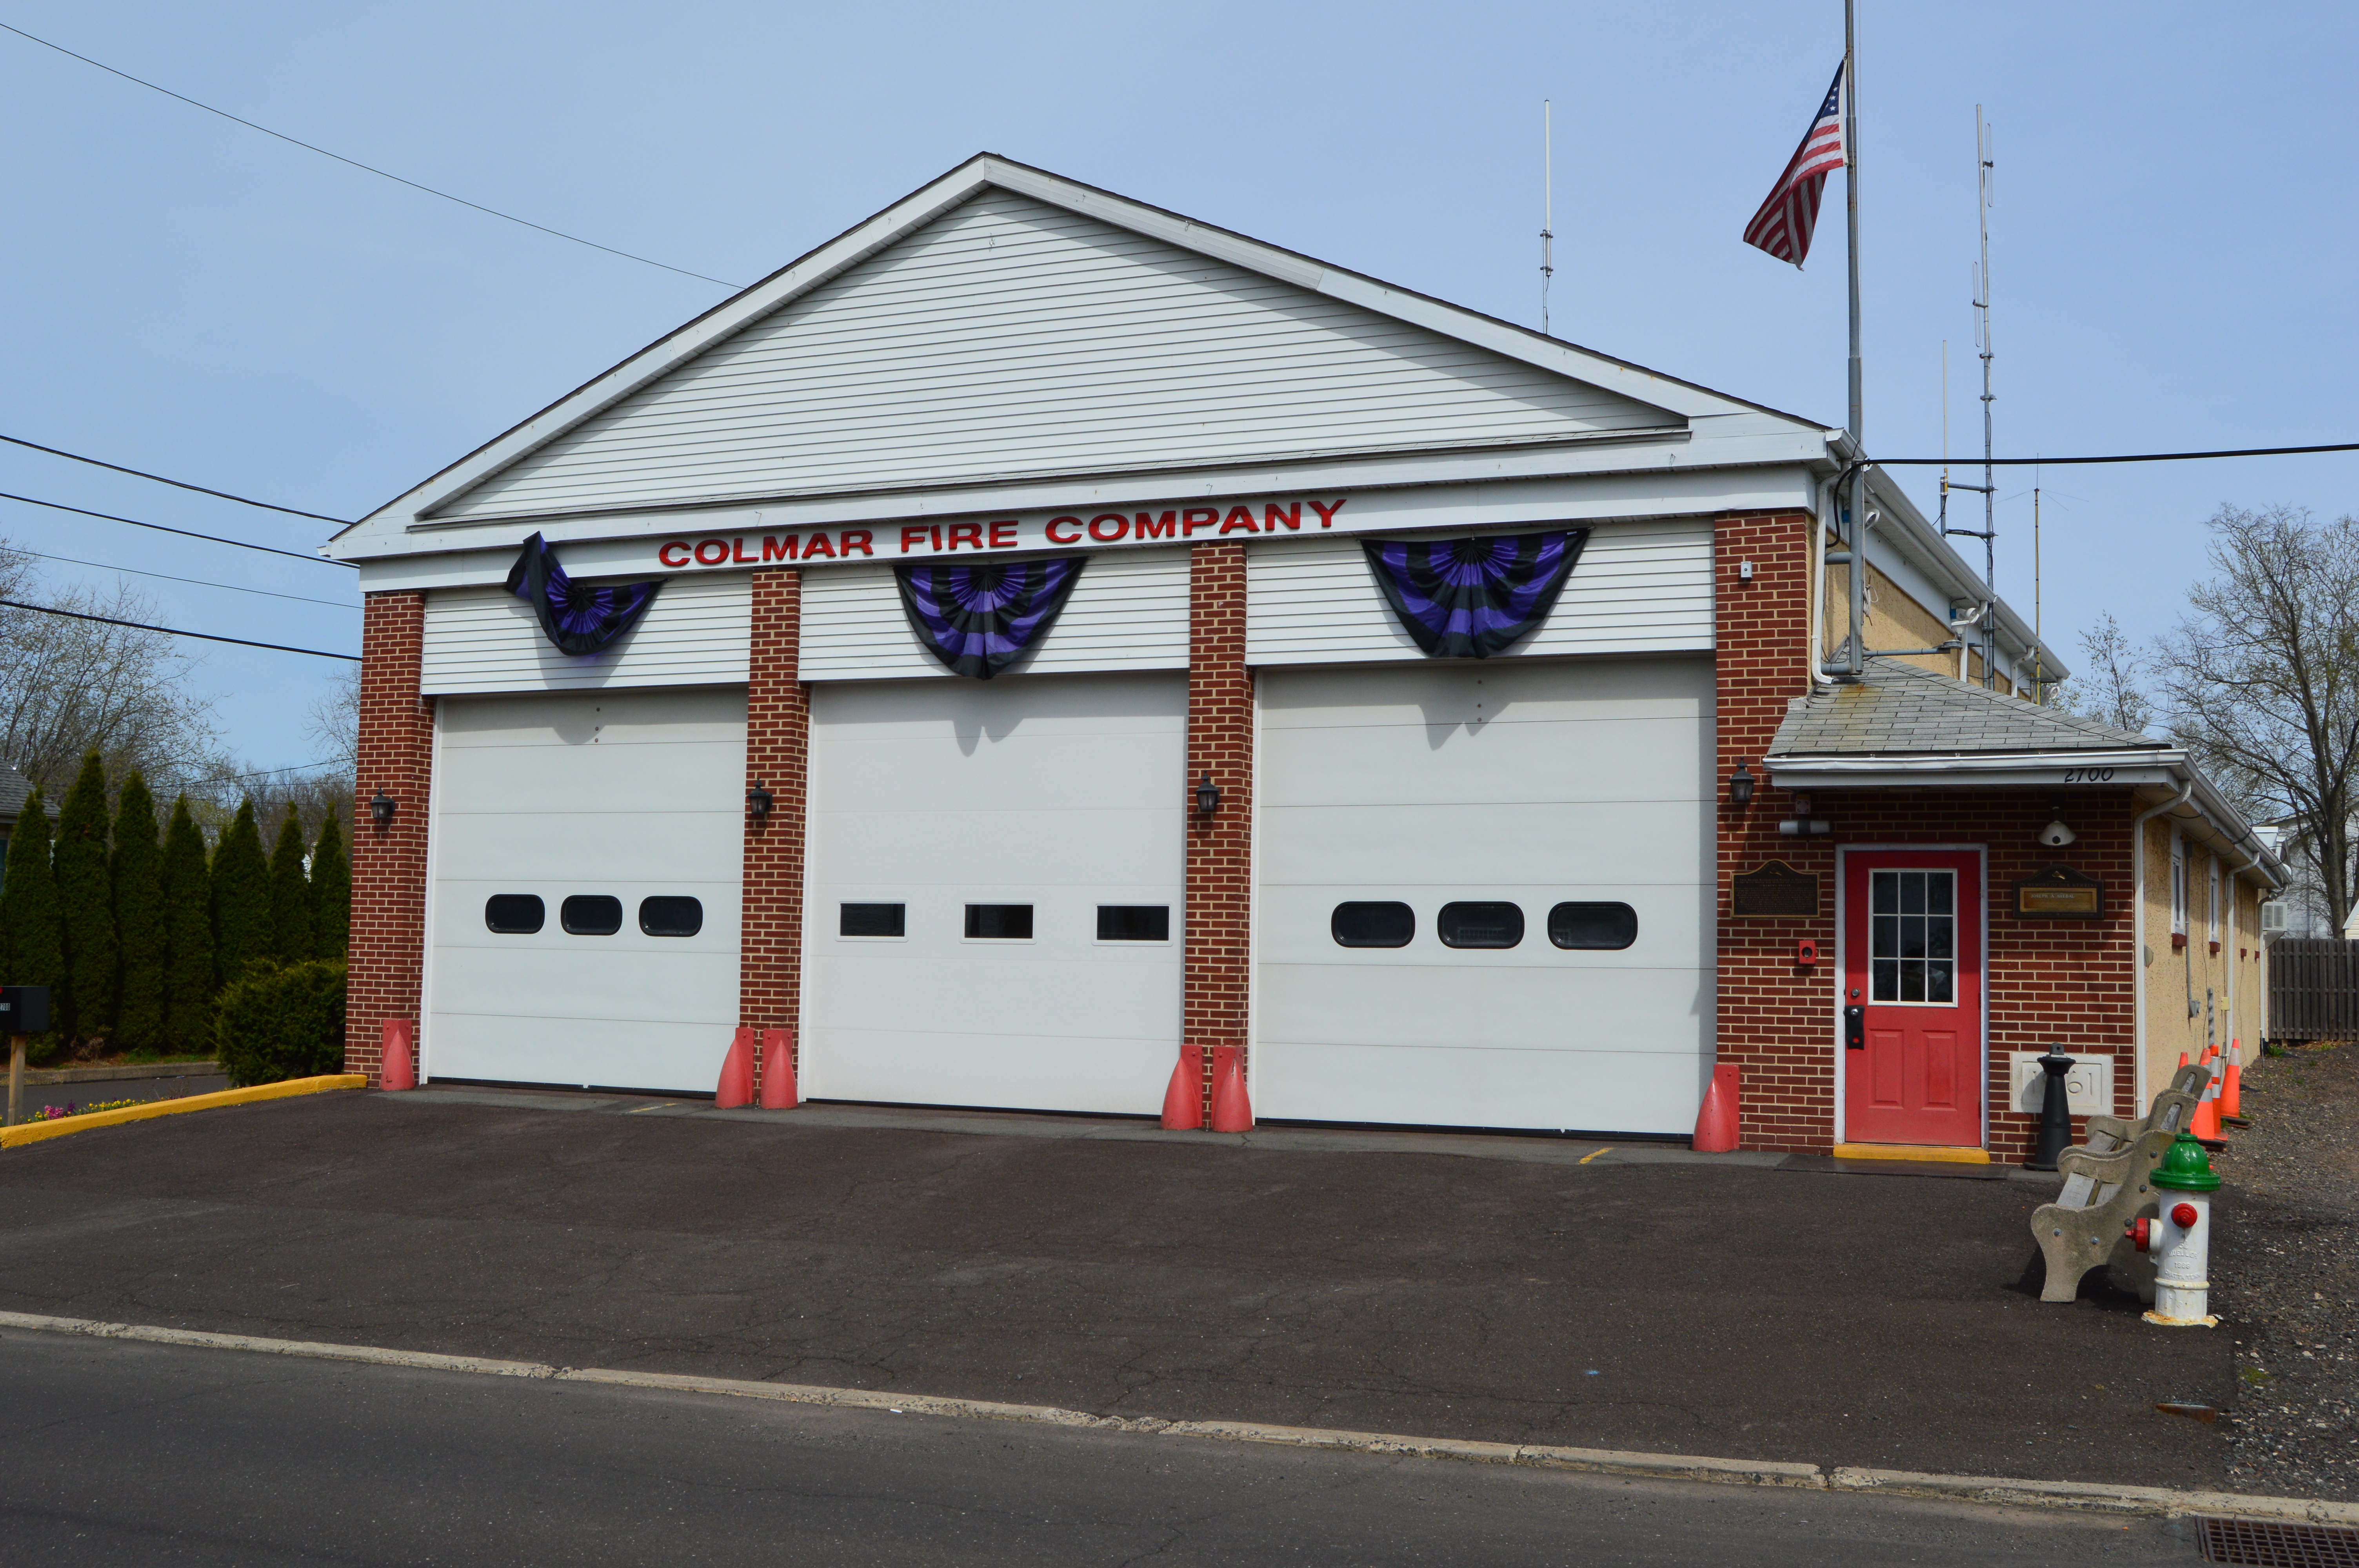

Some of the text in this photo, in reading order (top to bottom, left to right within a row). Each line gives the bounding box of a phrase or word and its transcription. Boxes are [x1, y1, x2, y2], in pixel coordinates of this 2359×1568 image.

[659, 499, 1347, 566] COLMAR FIRE COMPANY
[2065, 767, 2114, 783] 2700
[2032, 1070, 2093, 1096] 161
[2168, 1250, 2197, 1259] MUELLER
